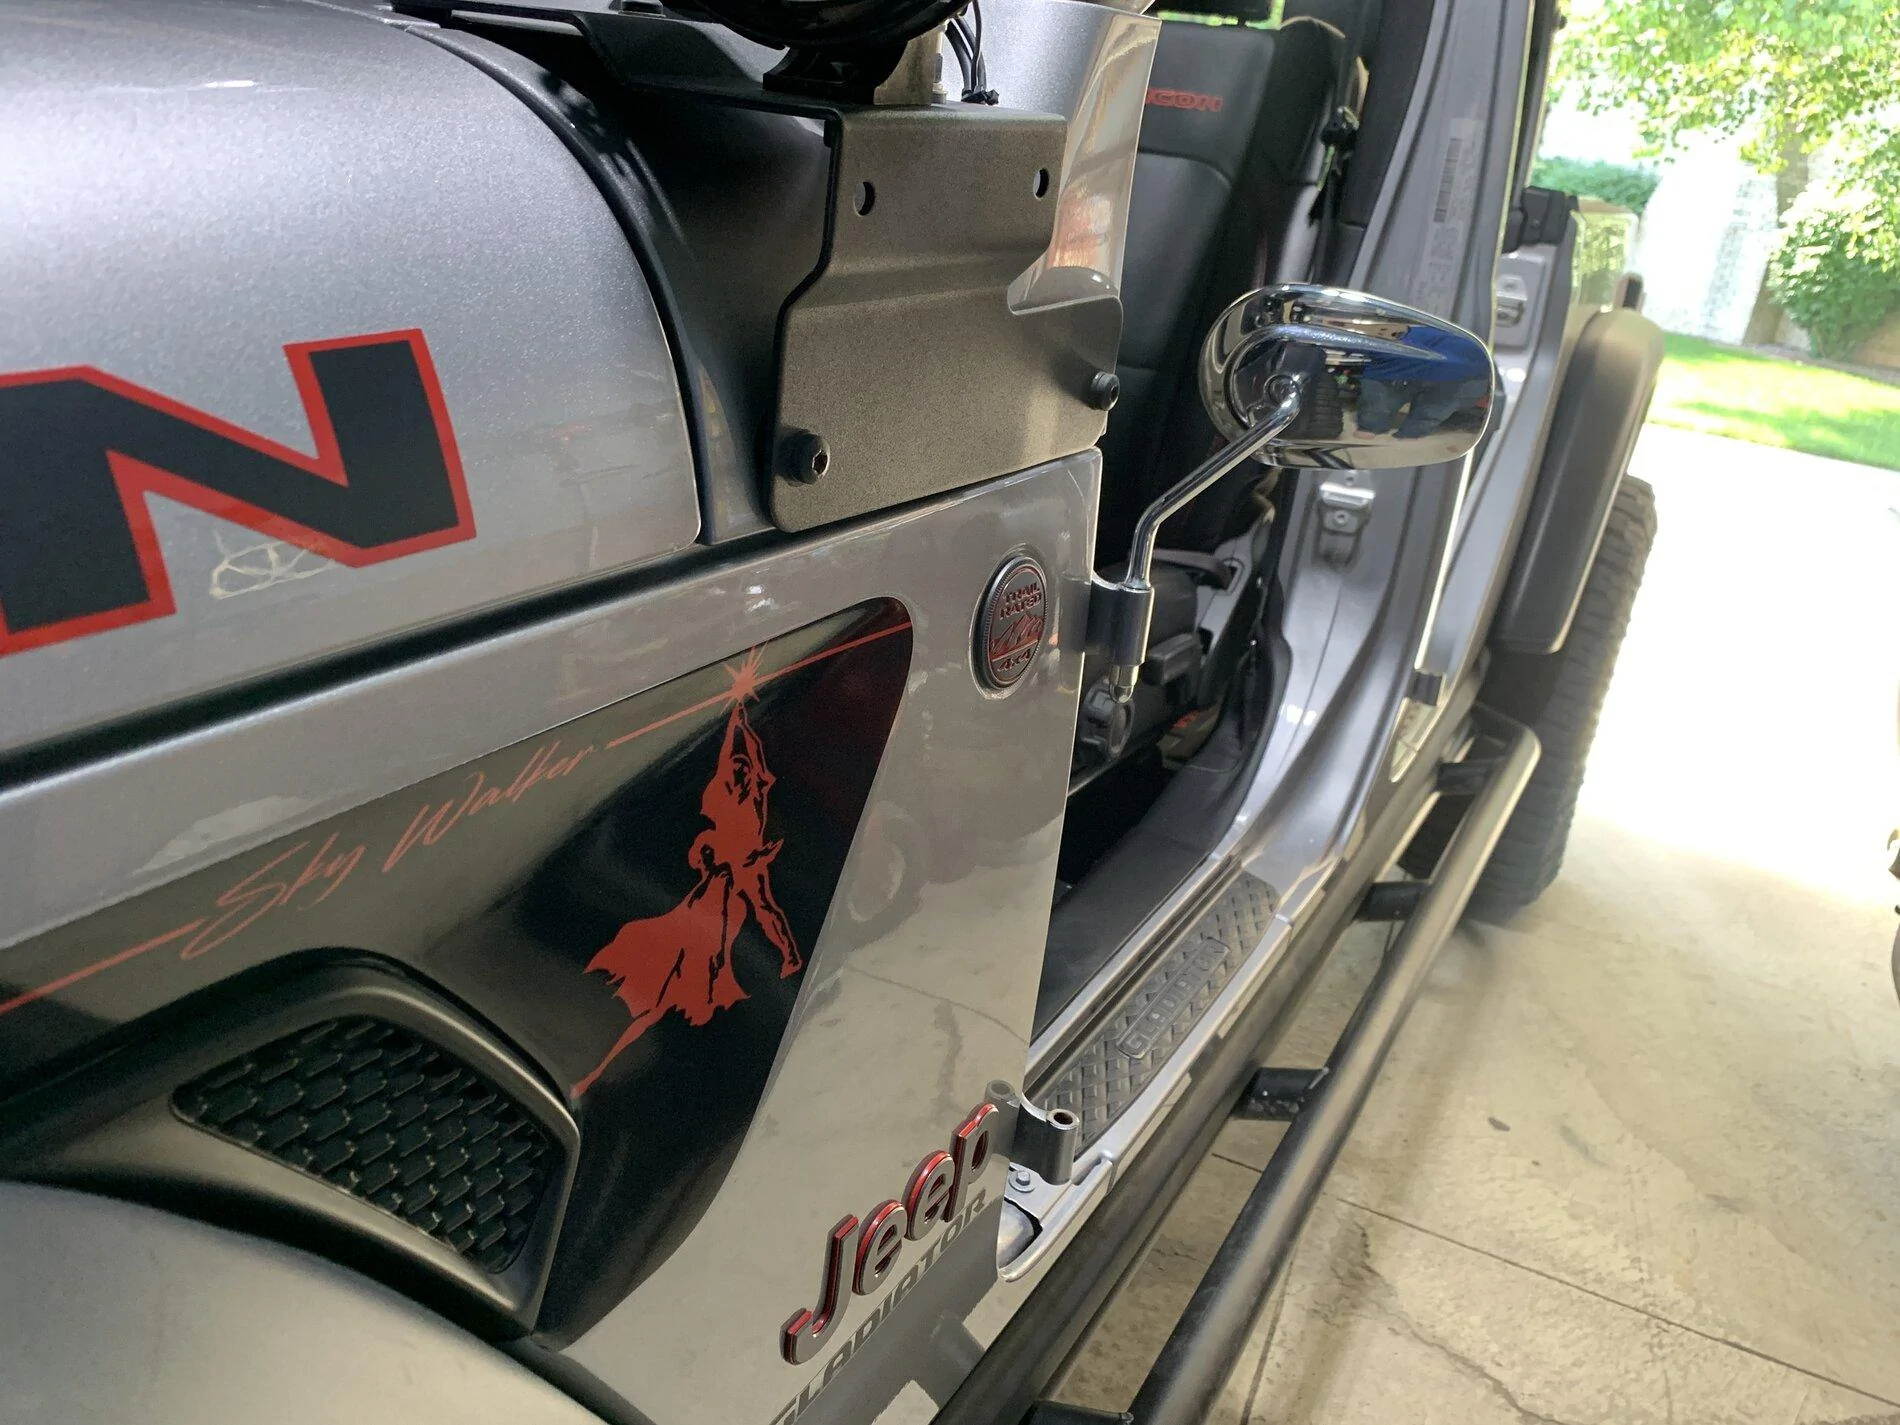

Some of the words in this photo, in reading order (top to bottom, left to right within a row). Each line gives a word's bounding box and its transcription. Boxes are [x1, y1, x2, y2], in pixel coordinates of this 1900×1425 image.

[1000, 593, 1042, 619] RATED
[1004, 582, 1040, 604] TRAIL
[180, 832, 366, 960] Sky
[382, 740, 594, 873] Walker
[780, 1103, 999, 1366] Jeep
